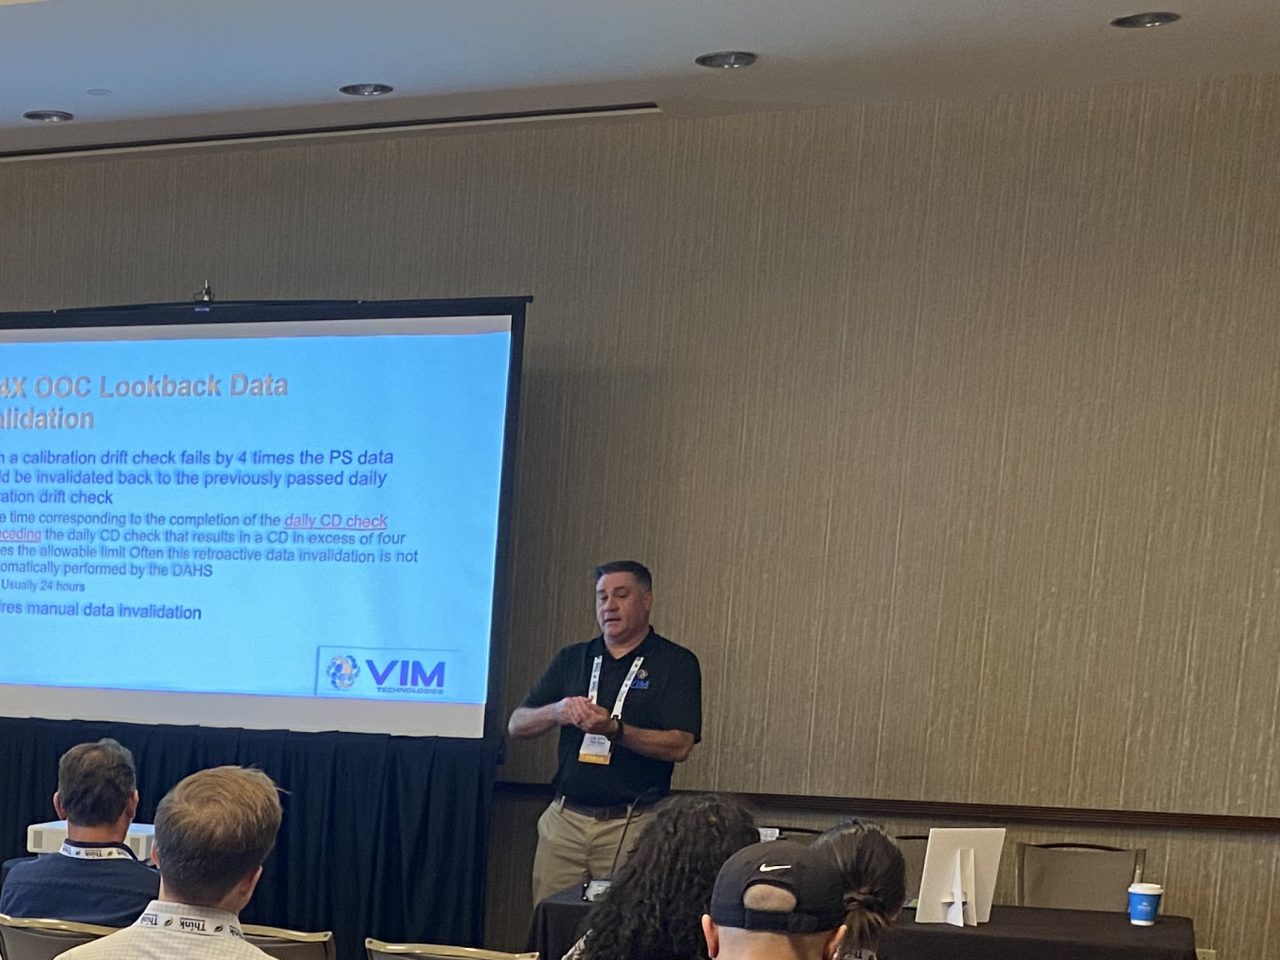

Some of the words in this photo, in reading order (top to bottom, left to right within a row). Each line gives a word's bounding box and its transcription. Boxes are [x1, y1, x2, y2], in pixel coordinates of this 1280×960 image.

[34, 375, 91, 398] OOC
[99, 373, 221, 398] Lookback
[230, 372, 288, 396] Data
[10, 454, 18, 464] a
[23, 450, 96, 465] calibration
[100, 450, 128, 465] drift
[132, 450, 176, 465] check
[181, 450, 210, 465] fails
[216, 451, 233, 467] by
[238, 451, 247, 464] 4
[253, 450, 294, 464] times
[300, 450, 324, 464] the
[329, 450, 352, 465] PS
[358, 450, 394, 465] data
[15, 470, 32, 484] be
[36, 470, 113, 485] invalidated
[118, 470, 152, 485] back
[158, 472, 171, 485] to
[176, 470, 199, 485] the
[204, 470, 281, 488] previously
[287, 471, 343, 488] passed
[349, 471, 387, 488] daily
[39, 489, 66, 504] drift
[70, 490, 113, 504] check
[10, 511, 35, 523] time
[39, 511, 126, 528] corresponding
[130, 513, 142, 525] to
[146, 512, 165, 525] the
[169, 513, 239, 529] completion
[244, 514, 257, 526] of
[260, 514, 281, 526] the
[284, 514, 316, 529] daily
[320, 514, 342, 527] CD
[346, 514, 387, 528] check
[45, 528, 64, 541] the
[67, 528, 96, 544] daily
[100, 529, 120, 542] CD
[124, 529, 160, 542] check
[165, 529, 188, 542] that
[192, 530, 235, 543] results
[240, 531, 250, 543] in
[255, 534, 263, 543] a
[267, 531, 289, 544] CD
[293, 531, 304, 544] in
[308, 534, 355, 545] excess
[360, 532, 373, 545] of
[378, 532, 407, 545] four
[18, 544, 36, 556] the
[40, 545, 97, 557] allowable
[101, 545, 125, 558] limit
[130, 546, 164, 559] Often
[168, 547, 190, 559] this
[194, 548, 262, 561] retroactive
[266, 549, 295, 561] data
[299, 550, 375, 563] invalidation
[380, 551, 391, 563] is
[396, 551, 418, 563] not
[63, 562, 126, 577] performed
[130, 563, 145, 578] by
[149, 563, 168, 576] the
[173, 564, 213, 577] DAHS
[1, 579, 37, 593] Usually
[40, 581, 53, 591] 24
[56, 581, 86, 592] hours
[27, 601, 79, 616] manual
[83, 603, 115, 617] data
[120, 604, 202, 620] invalidation
[365, 659, 446, 687] VIM
[376, 686, 444, 695] TECHNOLOGIES
